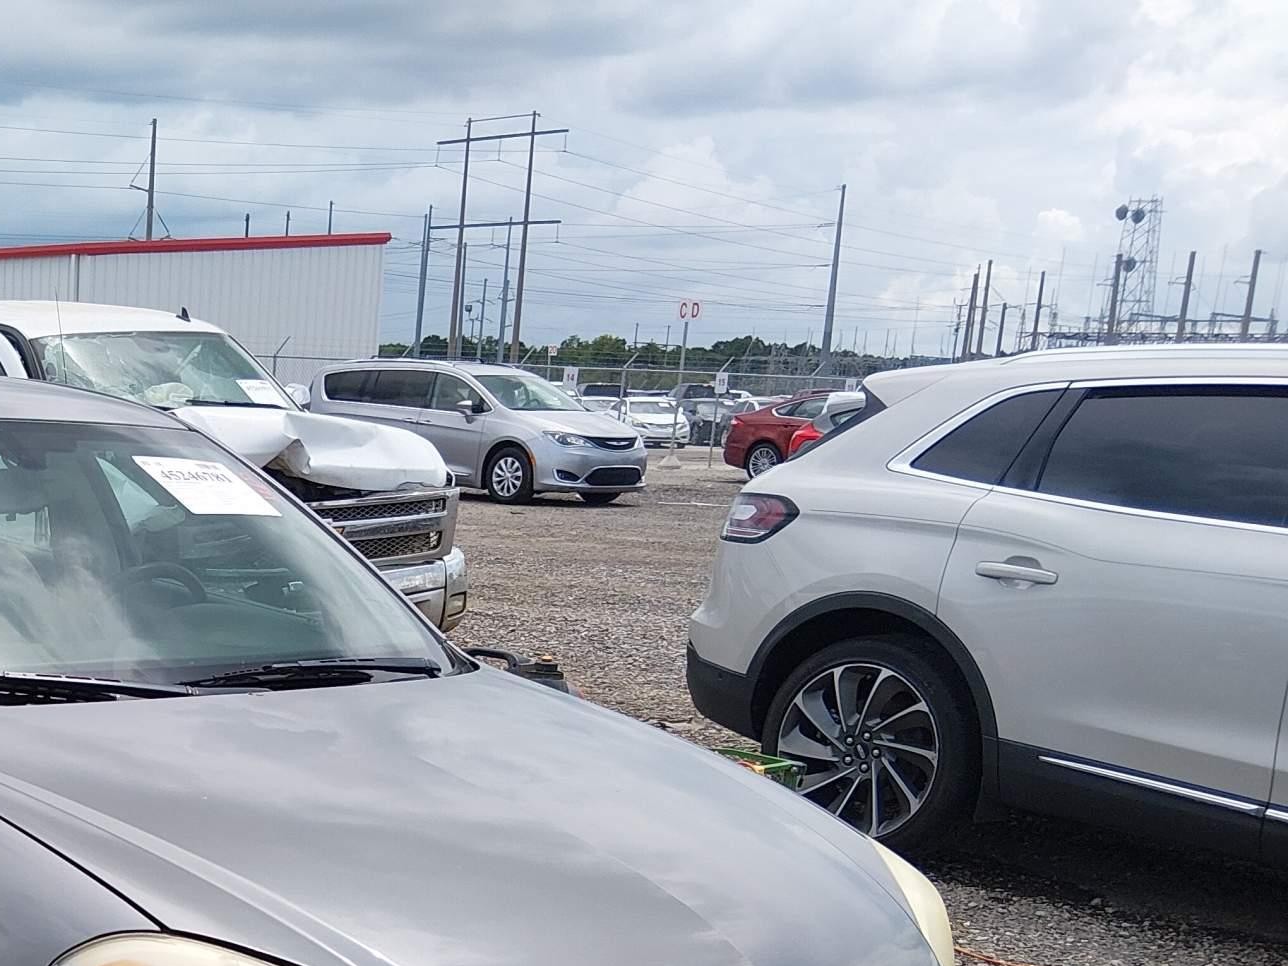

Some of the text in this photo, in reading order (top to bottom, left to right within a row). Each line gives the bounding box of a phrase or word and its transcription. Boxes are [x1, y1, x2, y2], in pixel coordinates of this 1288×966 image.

[680, 302, 700, 319] C D
[160, 470, 233, 483] 45246781
